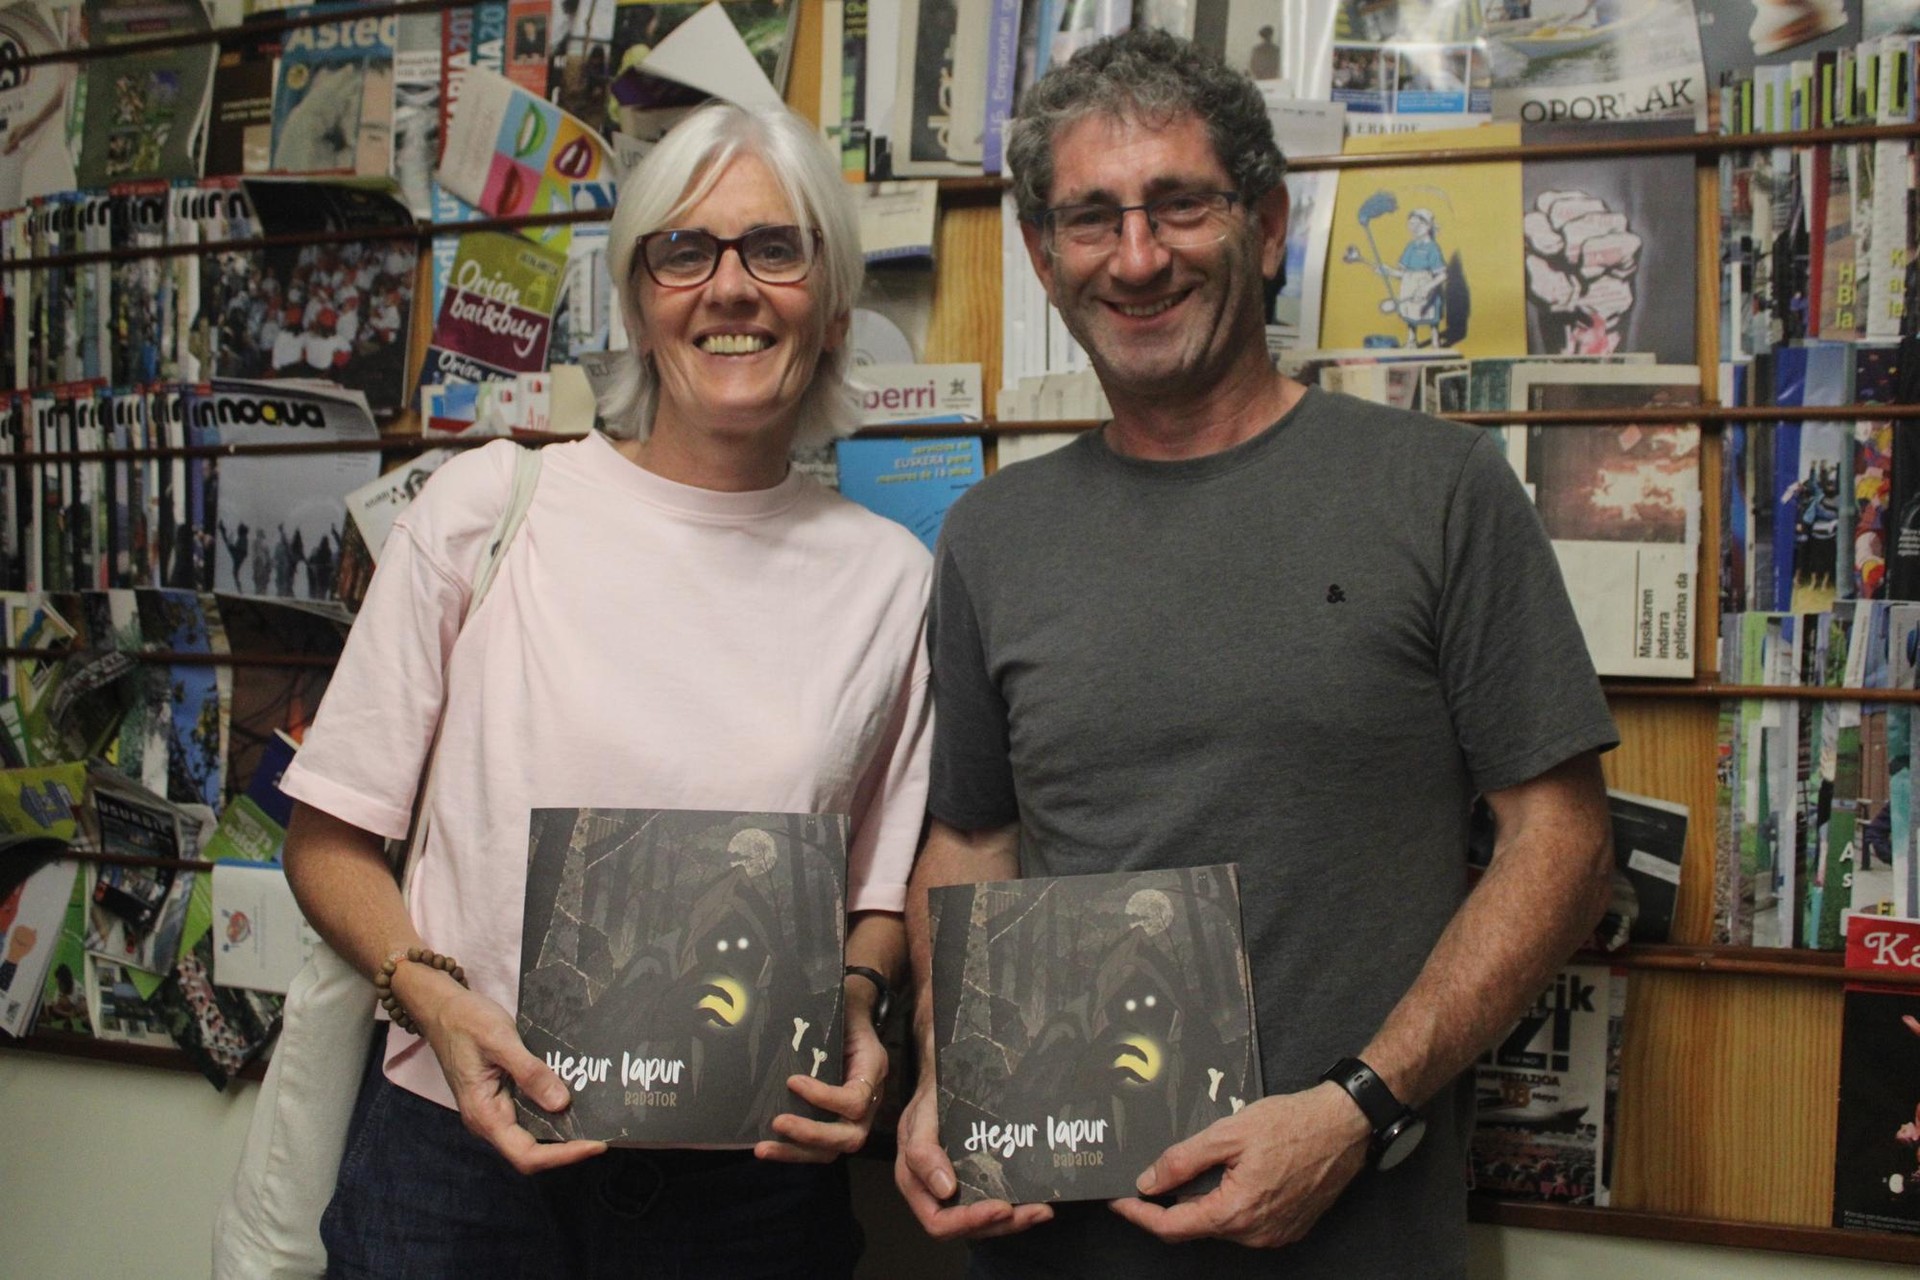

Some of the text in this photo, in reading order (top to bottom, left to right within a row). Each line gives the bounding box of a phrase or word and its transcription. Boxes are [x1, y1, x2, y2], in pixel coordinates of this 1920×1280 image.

[1675, 572, 1688, 590] da
[1639, 588, 1654, 659] Musikaren
[1656, 611, 1670, 659] indarra
[546, 1050, 685, 1092] Hezur lapur
[964, 1115, 1109, 1159] Hezur lapur
